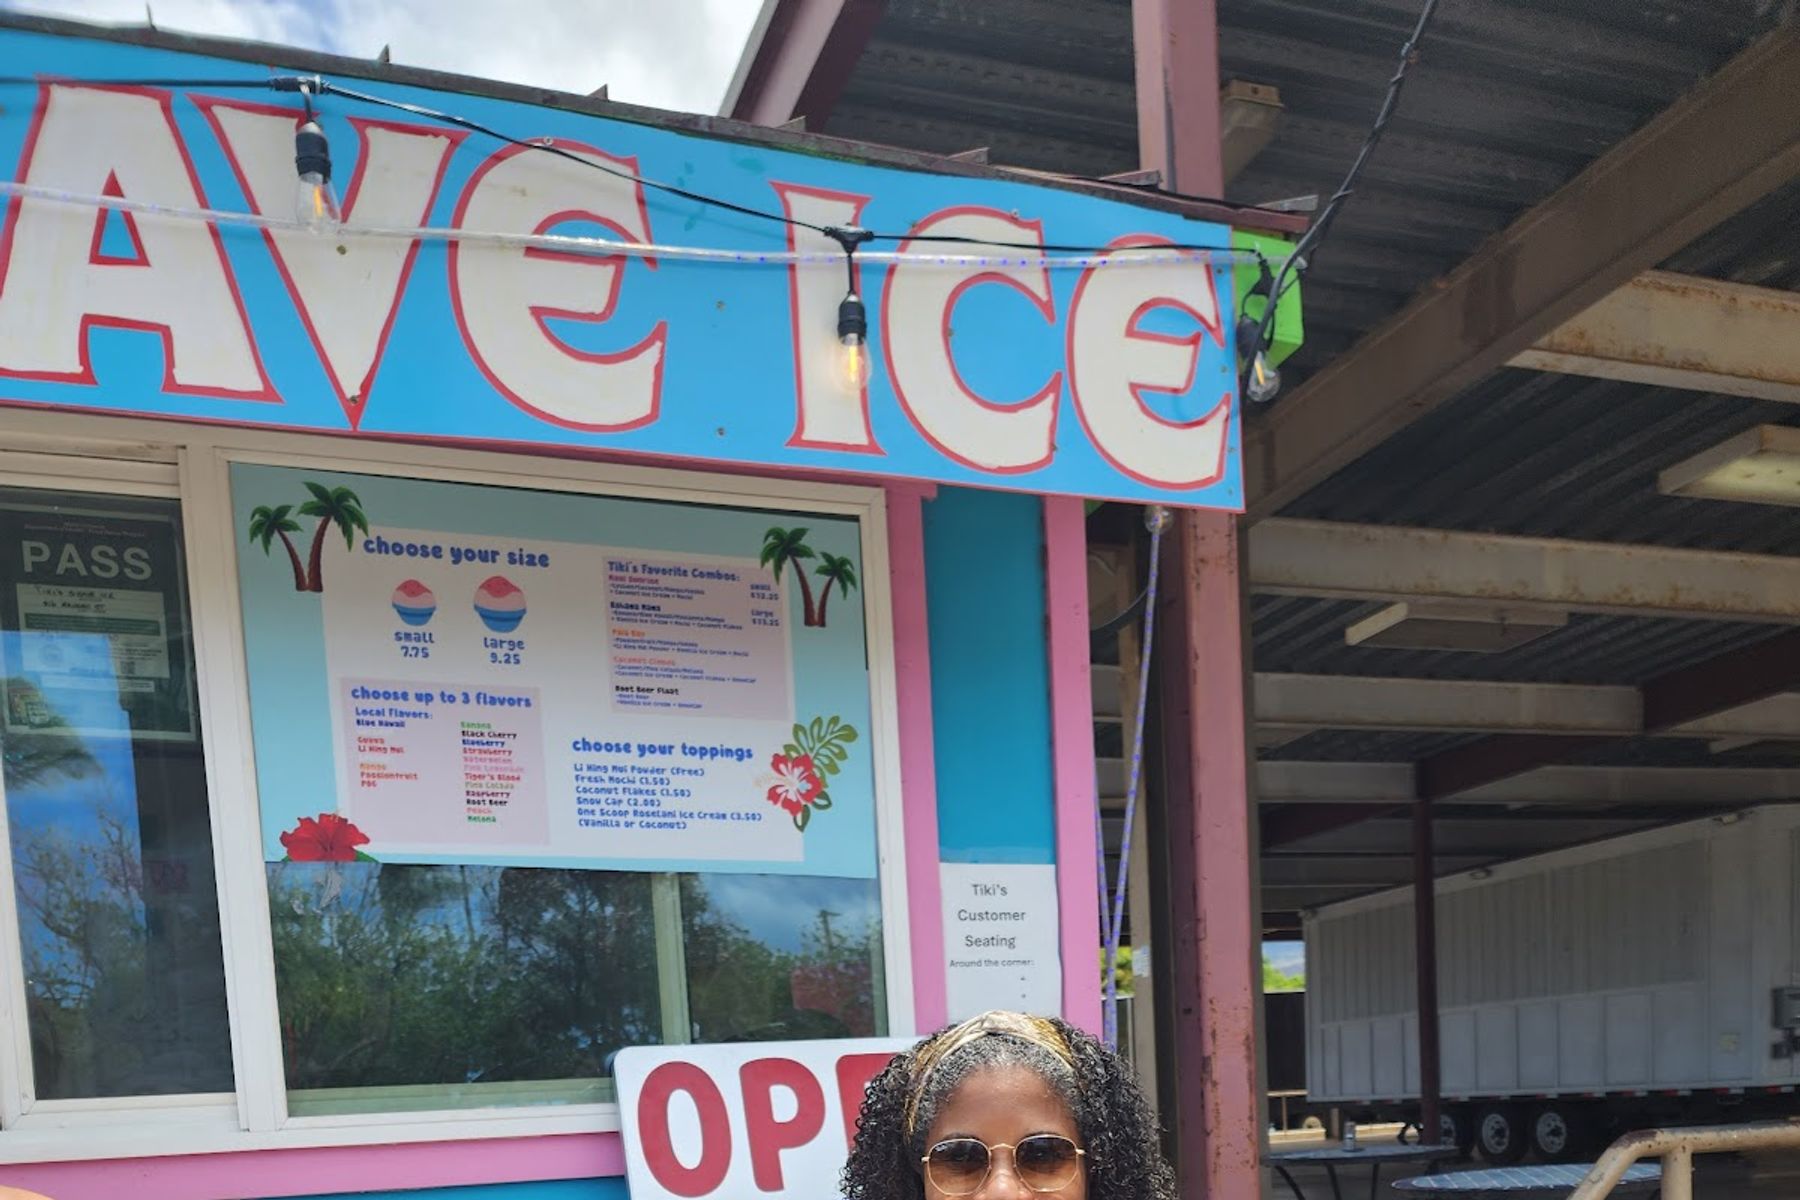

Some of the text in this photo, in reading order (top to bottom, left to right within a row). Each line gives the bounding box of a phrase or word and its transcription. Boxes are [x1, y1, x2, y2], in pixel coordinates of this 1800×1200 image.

[770, 181, 1231, 491] ICE
[363, 536, 550, 568] choose your size
[21, 540, 153, 581] PASS
[642, 564, 689, 577] Favorite
[394, 631, 435, 644] small
[483, 637, 525, 651] large
[401, 646, 430, 659] 7.75
[490, 652, 521, 665] 9.25
[351, 686, 532, 708] choose up to 3 flavors
[355, 707, 385, 717] Local
[461, 730, 518, 740] Black Cherry
[572, 737, 753, 762] choose your toppings
[573, 763, 583, 772] Li
[586, 764, 609, 773] Hing
[630, 765, 666, 774] Powder
[575, 774, 606, 784] Fresh
[575, 786, 618, 795] Coconut
[622, 787, 657, 796] Flakes
[576, 796, 601, 805] Snow
[604, 797, 623, 807] Cap
[577, 807, 597, 816] One
[599, 808, 629, 818] Scoop
[632, 809, 677, 819] Roselani
[679, 811, 694, 819] Ice
[697, 811, 727, 820] Cream
[623, 820, 635, 828] or
[639, 820, 687, 830] Coconut)
[971, 883, 1008, 896] Tiki's
[957, 908, 1026, 921] Customer
[964, 934, 1017, 950] Seating
[949, 959, 983, 968] Around
[984, 959, 999, 967] the
